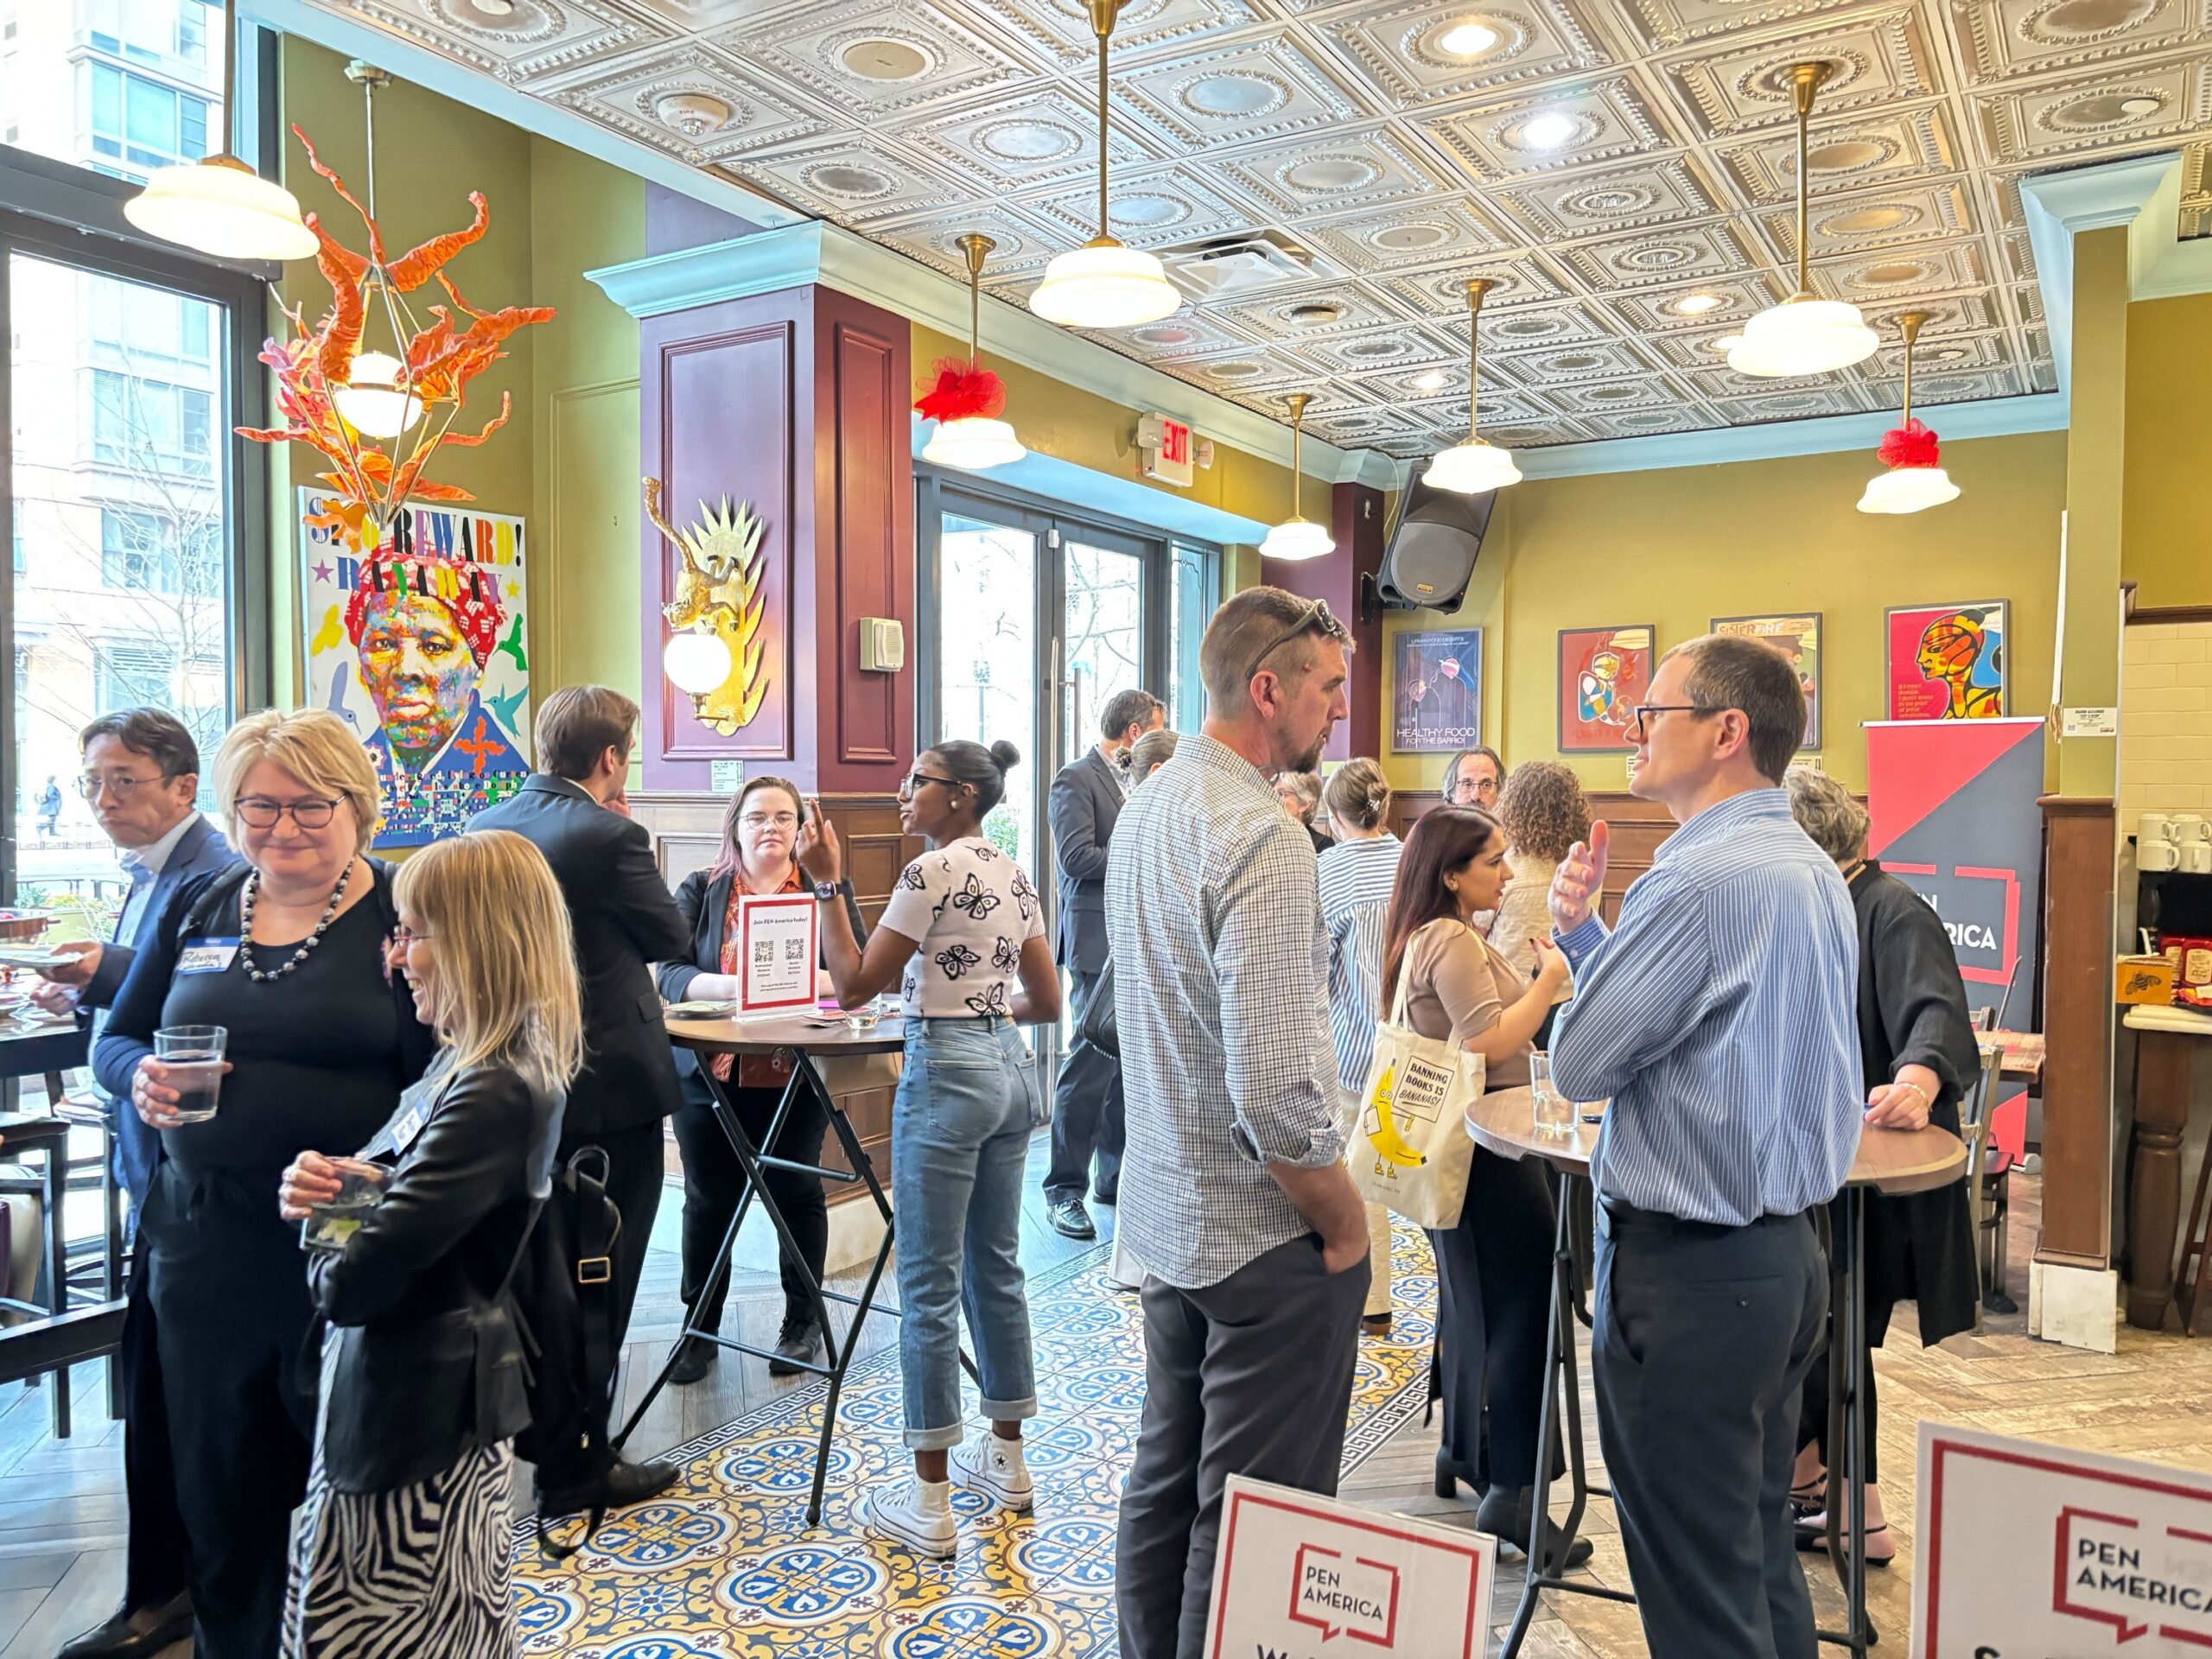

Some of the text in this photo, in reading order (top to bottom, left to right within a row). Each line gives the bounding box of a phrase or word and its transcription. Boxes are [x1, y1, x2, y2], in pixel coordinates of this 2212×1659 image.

[299, 420, 323, 466] EXIT
[393, 507, 521, 567] REWARD!
[1396, 728, 1475, 738] HEALTHY FOOD
[452, 780, 480, 791] aboe
[1942, 921, 1997, 950] RICA
[1405, 1074, 1444, 1096] BOOKS IS
[1410, 1063, 1448, 1084] BANNING
[1398, 1089, 1442, 1106] BANANAS!
[2077, 1538, 2139, 1570] PEN
[1306, 1566, 1341, 1589] PEN
[1303, 1587, 1383, 1621] AMERICA
